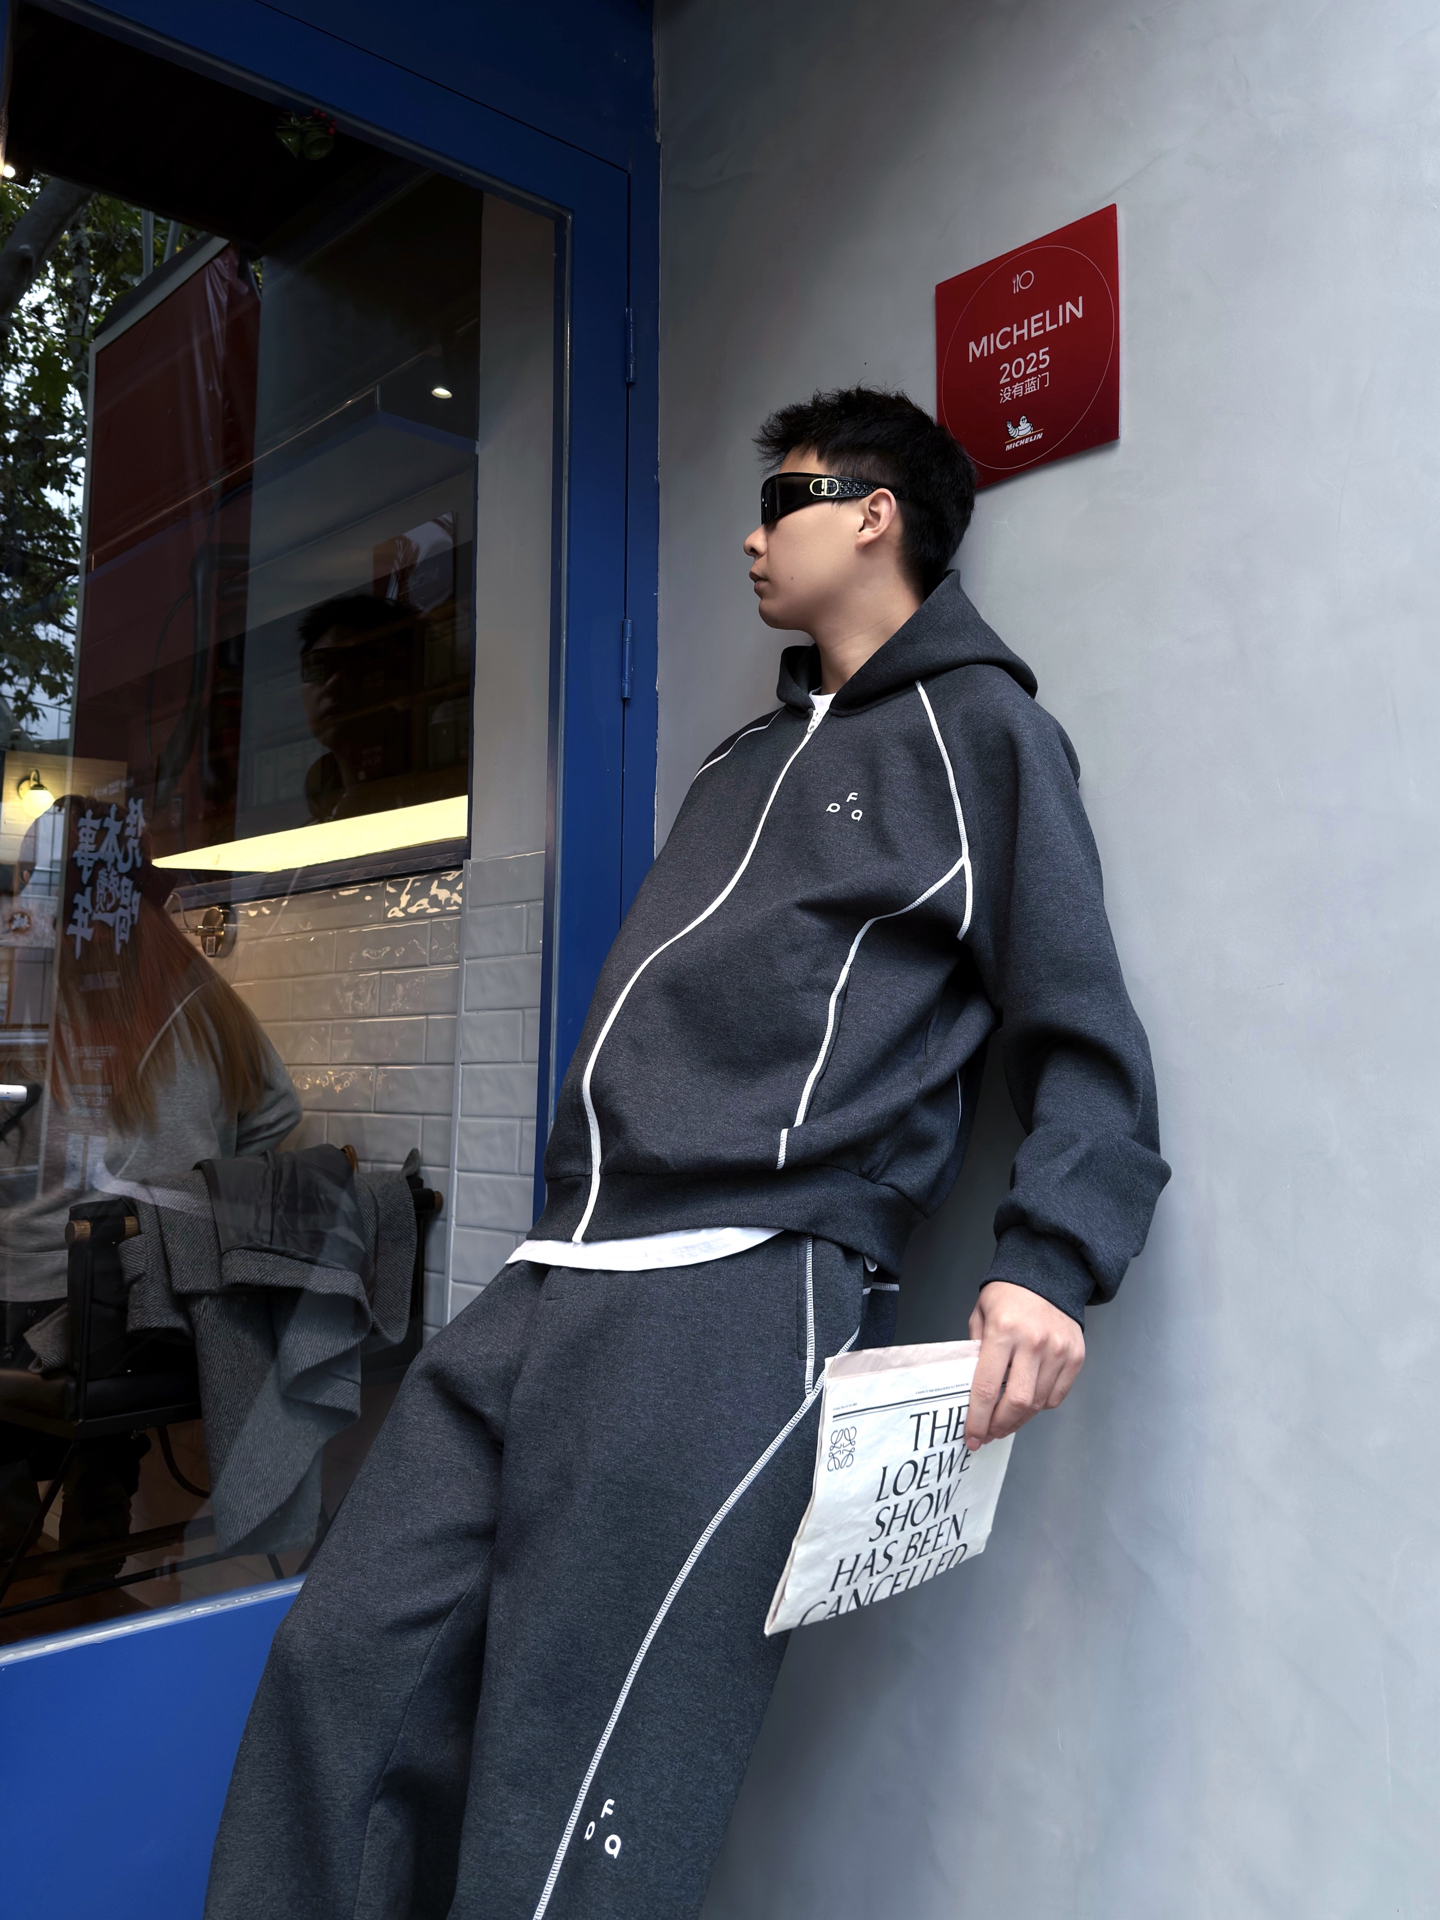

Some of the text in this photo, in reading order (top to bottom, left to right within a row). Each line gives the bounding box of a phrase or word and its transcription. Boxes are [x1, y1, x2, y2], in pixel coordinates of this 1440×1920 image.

[968, 296, 1084, 362] MICHELIN
[999, 347, 1050, 385] 2025
[999, 372, 1050, 404] 没有蓝门
[1005, 433, 1043, 451] MICHELIN
[910, 1404, 969, 1451] THE
[875, 1444, 971, 1502] LOEWE
[869, 1479, 961, 1542] SHOW
[829, 1508, 968, 1592] HAS BEEN
